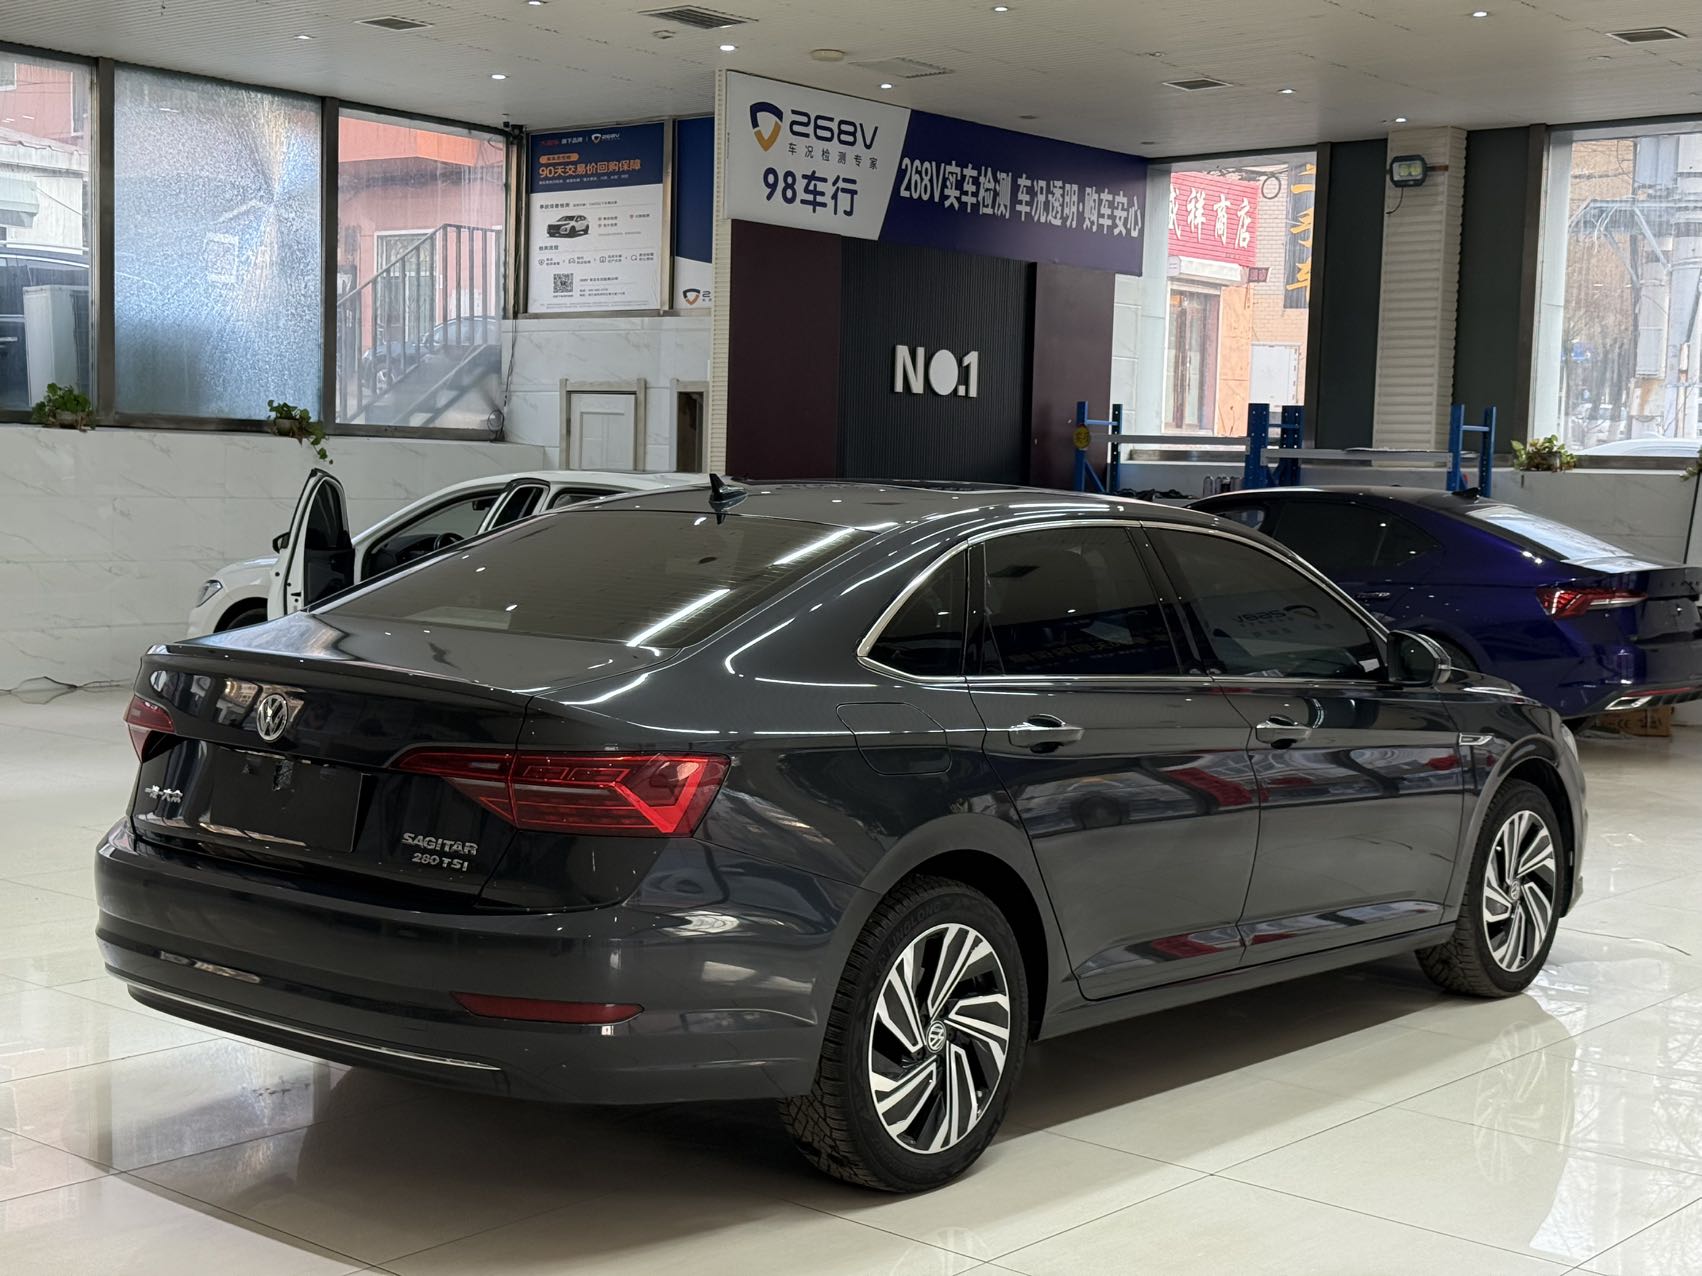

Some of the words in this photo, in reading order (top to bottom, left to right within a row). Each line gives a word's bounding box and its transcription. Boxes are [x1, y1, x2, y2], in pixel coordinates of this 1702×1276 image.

[788, 108, 879, 150] 268V
[539, 159, 641, 178] 90天交易价回购保障
[787, 142, 878, 170] 车况检测专家
[762, 166, 858, 216] 98车行
[899, 157, 1012, 219] 268V实车检测
[894, 344, 979, 398] NO.1
[402, 832, 479, 856] SAGITAR
[411, 852, 440, 865] 280
[441, 857, 469, 872] TSI
